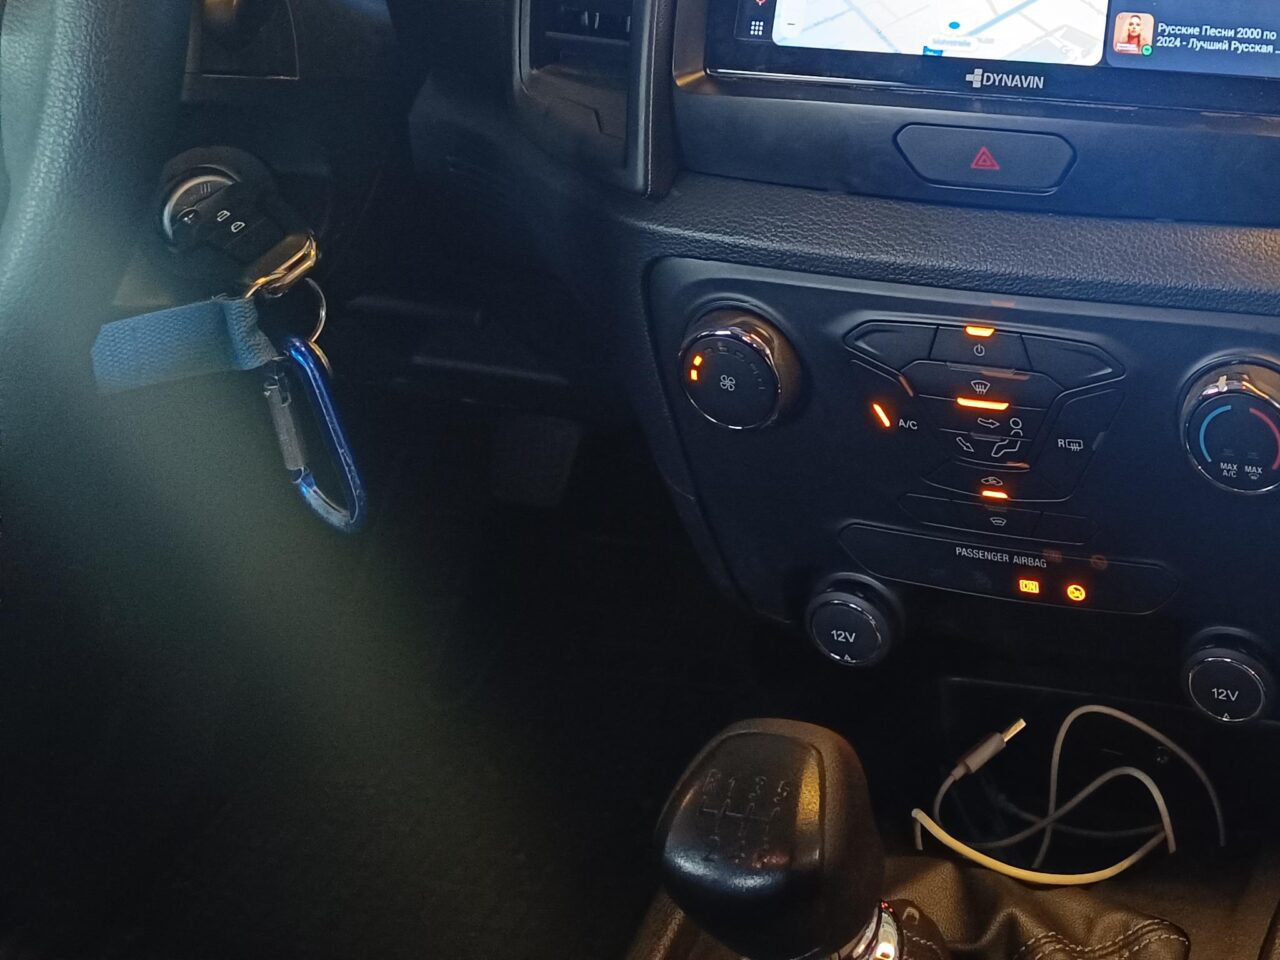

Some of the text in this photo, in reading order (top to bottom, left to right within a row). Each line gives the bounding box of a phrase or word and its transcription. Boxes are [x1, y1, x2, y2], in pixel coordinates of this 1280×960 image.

[1158, 23, 1277, 40] Русские Песни 2000 по
[1156, 36, 1273, 54] 2024 Лучший Русская
[983, 72, 1044, 89] DYNAVIN
[899, 419, 918, 430] A/C
[1058, 439, 1065, 448] R
[1220, 462, 1238, 471] MAX
[1244, 465, 1263, 474] MAX
[1222, 470, 1237, 478] A/C
[956, 547, 1047, 568] PASSENGER AIRBAG
[831, 629, 856, 643] 12V
[1212, 687, 1239, 701] 12V
